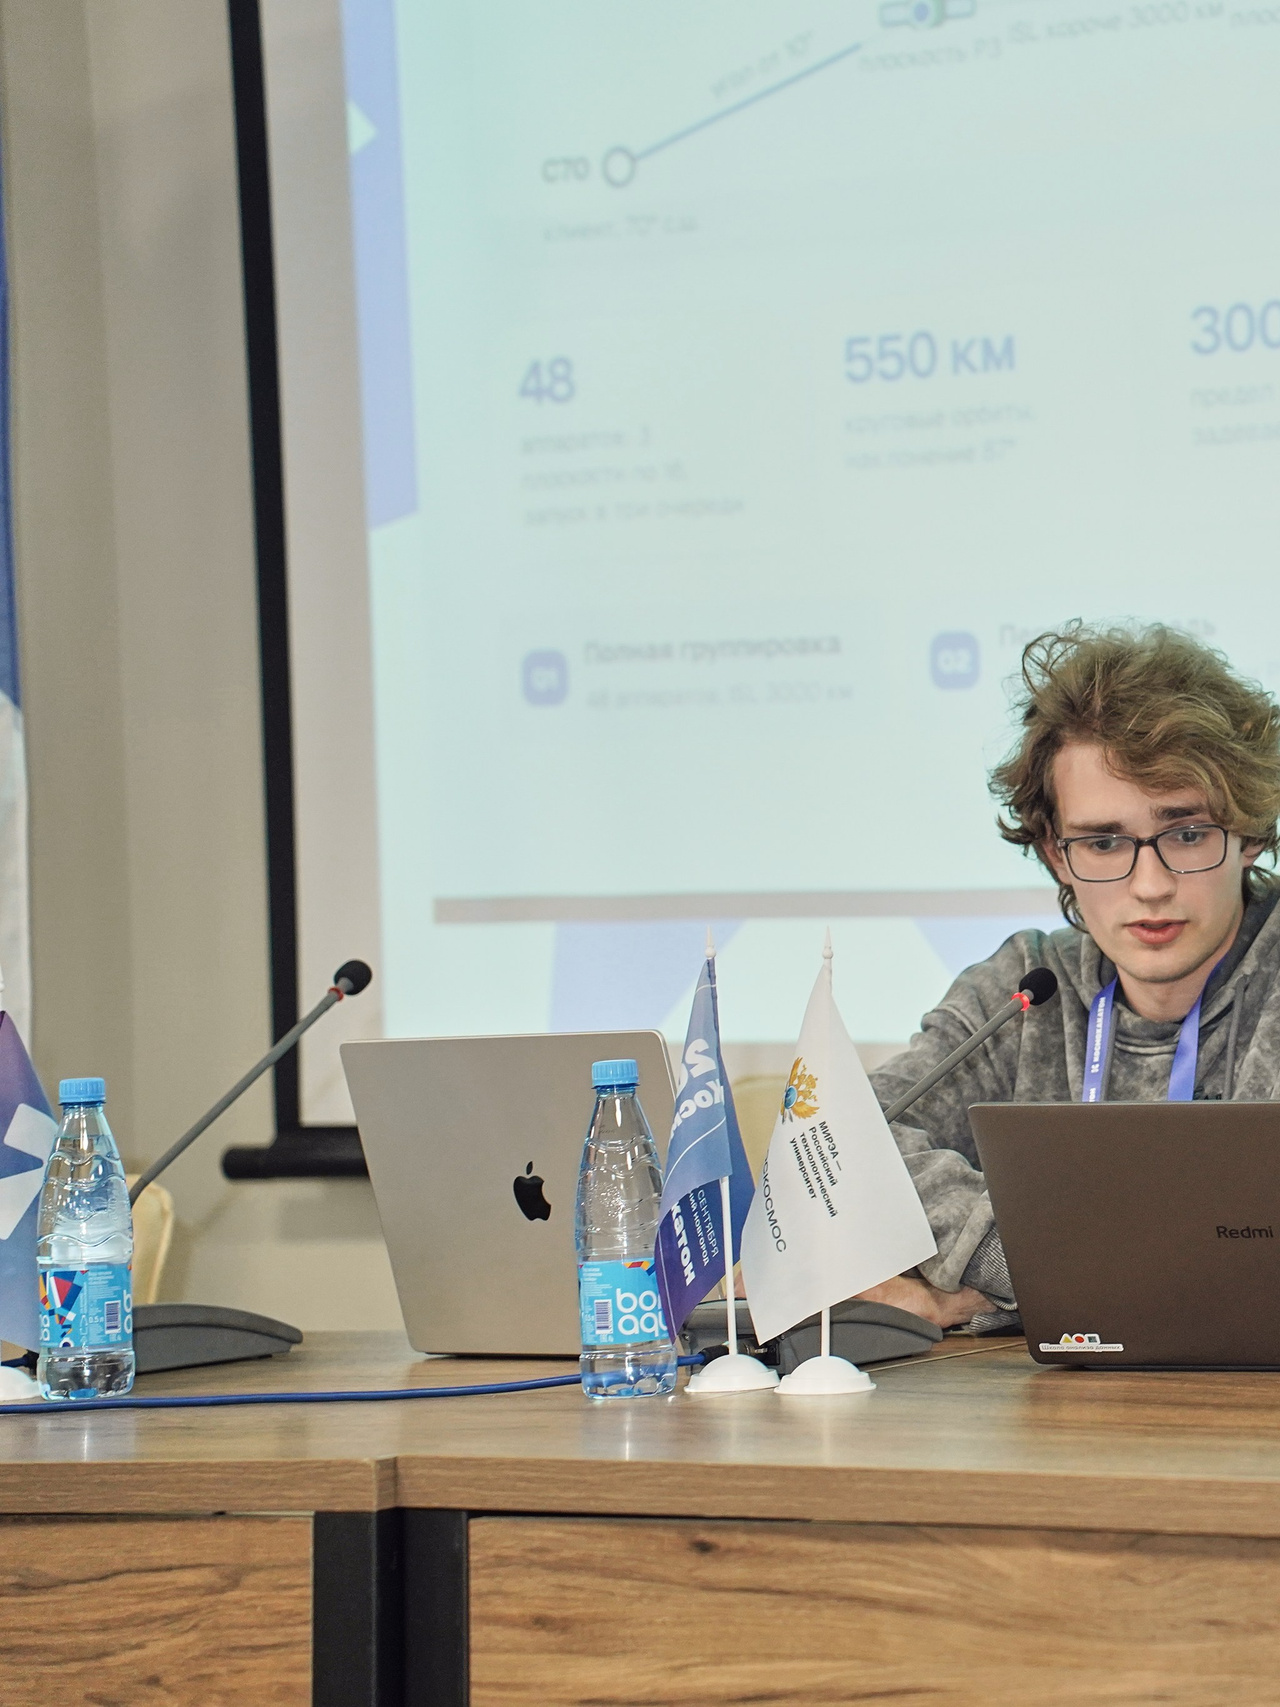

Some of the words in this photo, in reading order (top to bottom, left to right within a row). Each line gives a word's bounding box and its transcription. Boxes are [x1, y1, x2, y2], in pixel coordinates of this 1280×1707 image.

[541, 155, 591, 184] C70
[518, 355, 576, 406] 48
[844, 328, 939, 385] 550
[789, 1136, 818, 1200] университет
[808, 1126, 838, 1188] Российский
[818, 1121, 839, 1161] МИРЭА
[799, 1132, 839, 1218] технологический
[671, 1203, 695, 1287] катон
[692, 1212, 710, 1267] НОВГОРОД
[697, 1189, 720, 1258] СЕНТЯБРЯ
[1216, 1225, 1274, 1239] Redmi
[616, 1288, 660, 1313] bo
[618, 1312, 667, 1337] aqu
